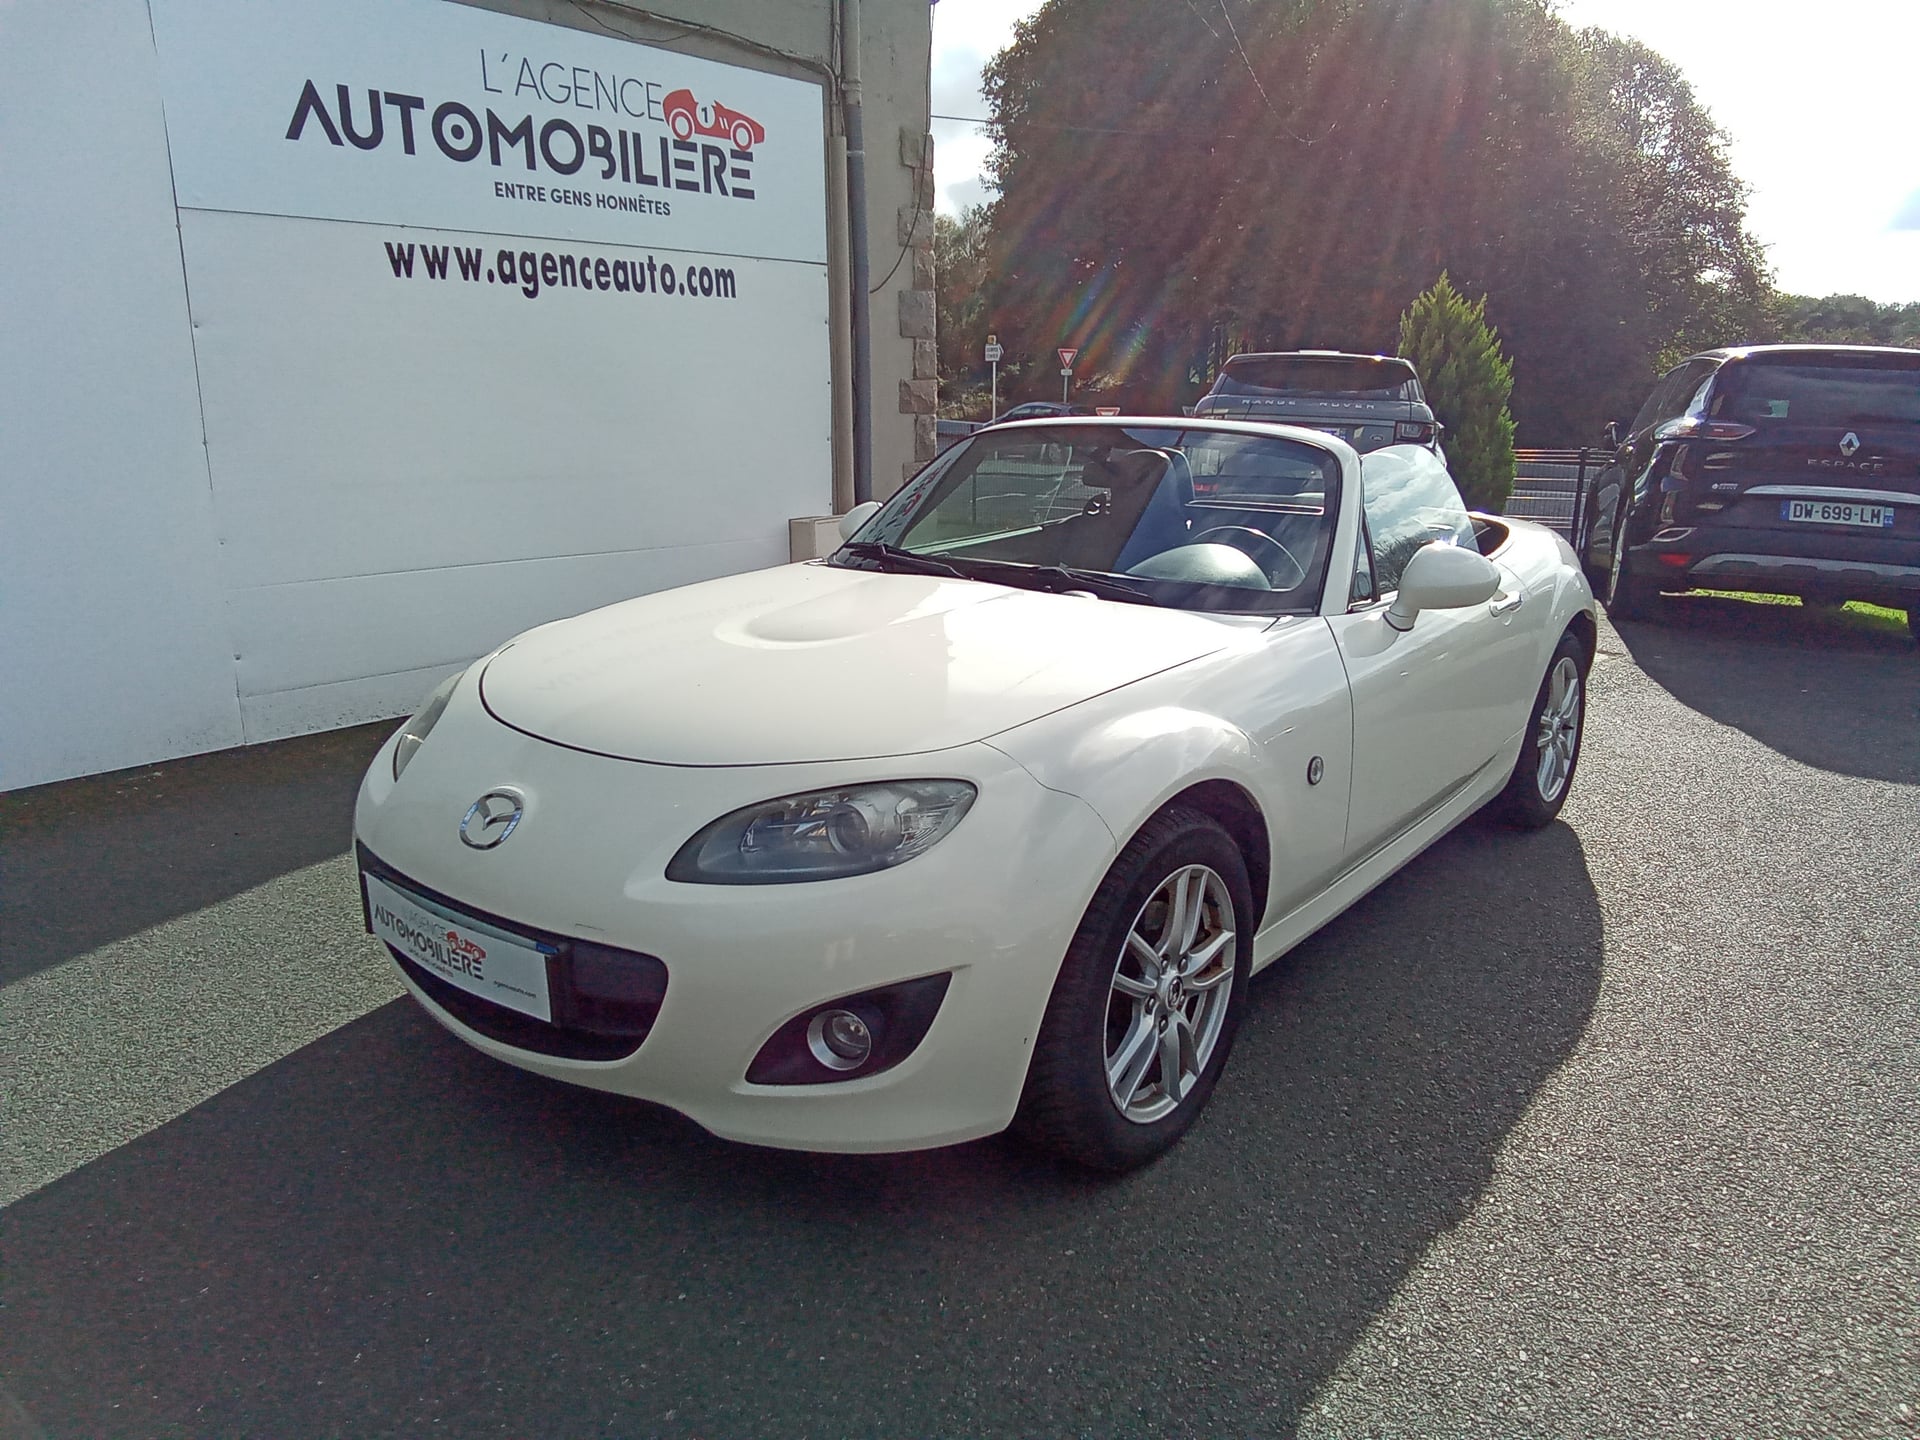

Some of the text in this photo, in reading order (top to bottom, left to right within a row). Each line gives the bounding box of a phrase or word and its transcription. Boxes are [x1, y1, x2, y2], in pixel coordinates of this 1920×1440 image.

[481, 48, 664, 122] L'AGENCE
[494, 181, 671, 216] ENTRE GENS HONNÊTES
[384, 242, 736, 299] www.agenceauto.com
[1807, 459, 1883, 470] ESPACE
[1793, 503, 1880, 524] DW-699-LM
